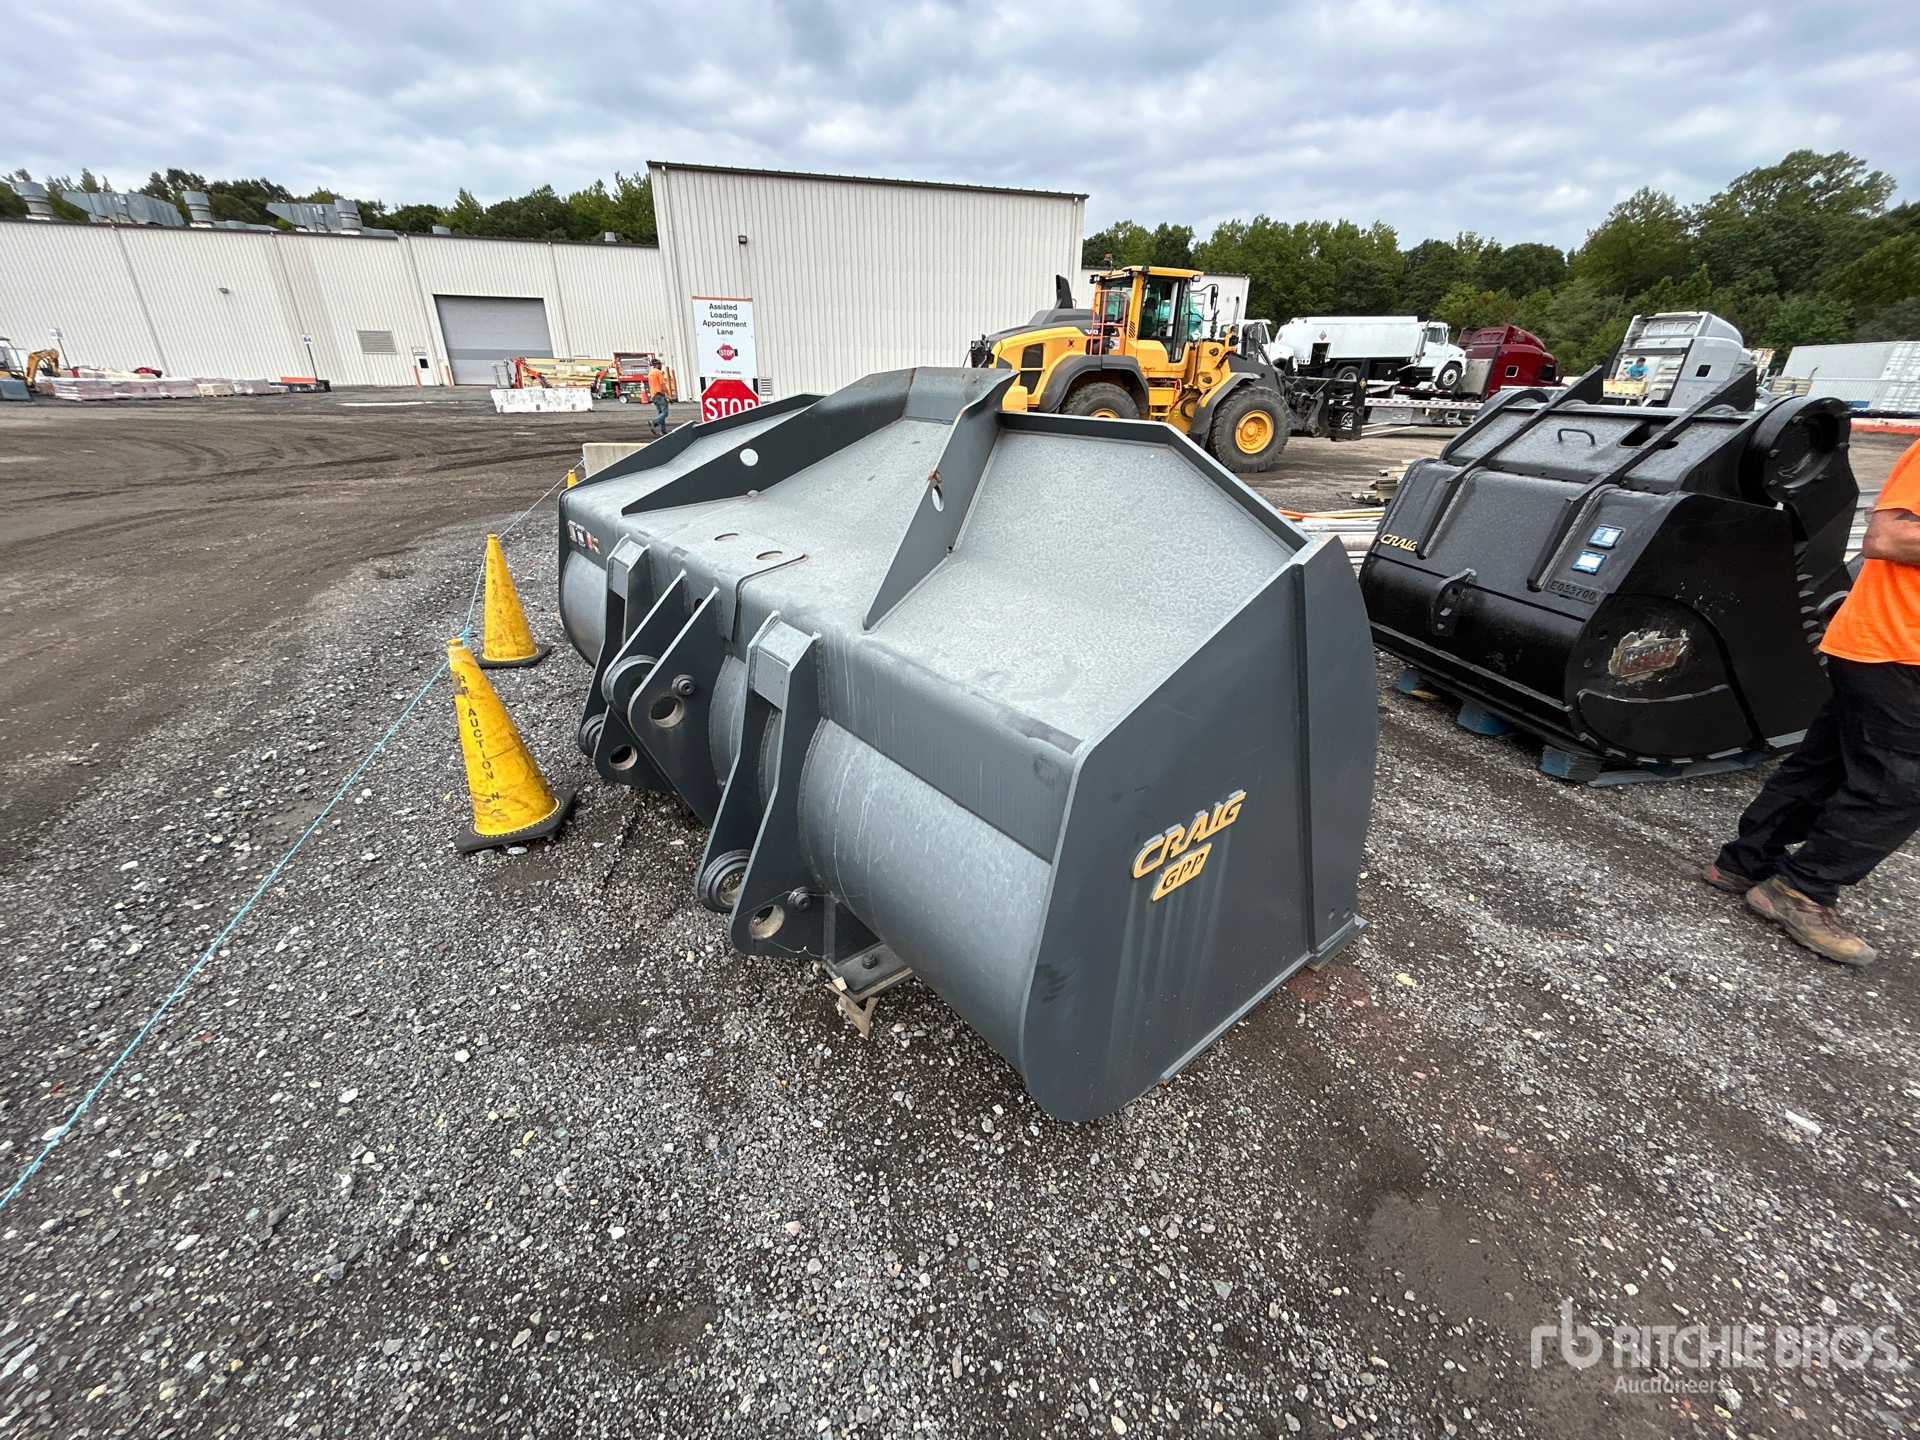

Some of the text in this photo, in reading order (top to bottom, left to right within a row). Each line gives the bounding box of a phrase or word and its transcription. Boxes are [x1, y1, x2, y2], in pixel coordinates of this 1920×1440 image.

[709, 303, 738, 311] Assisted
[710, 312, 738, 320] Loading
[702, 320, 747, 328] Appointment
[717, 328, 734, 336] Lane
[1380, 534, 1418, 552] CRAIG
[468, 708, 494, 780] AUCTION
[1133, 790, 1247, 879] CRAIG
[1161, 852, 1205, 891] GPP
